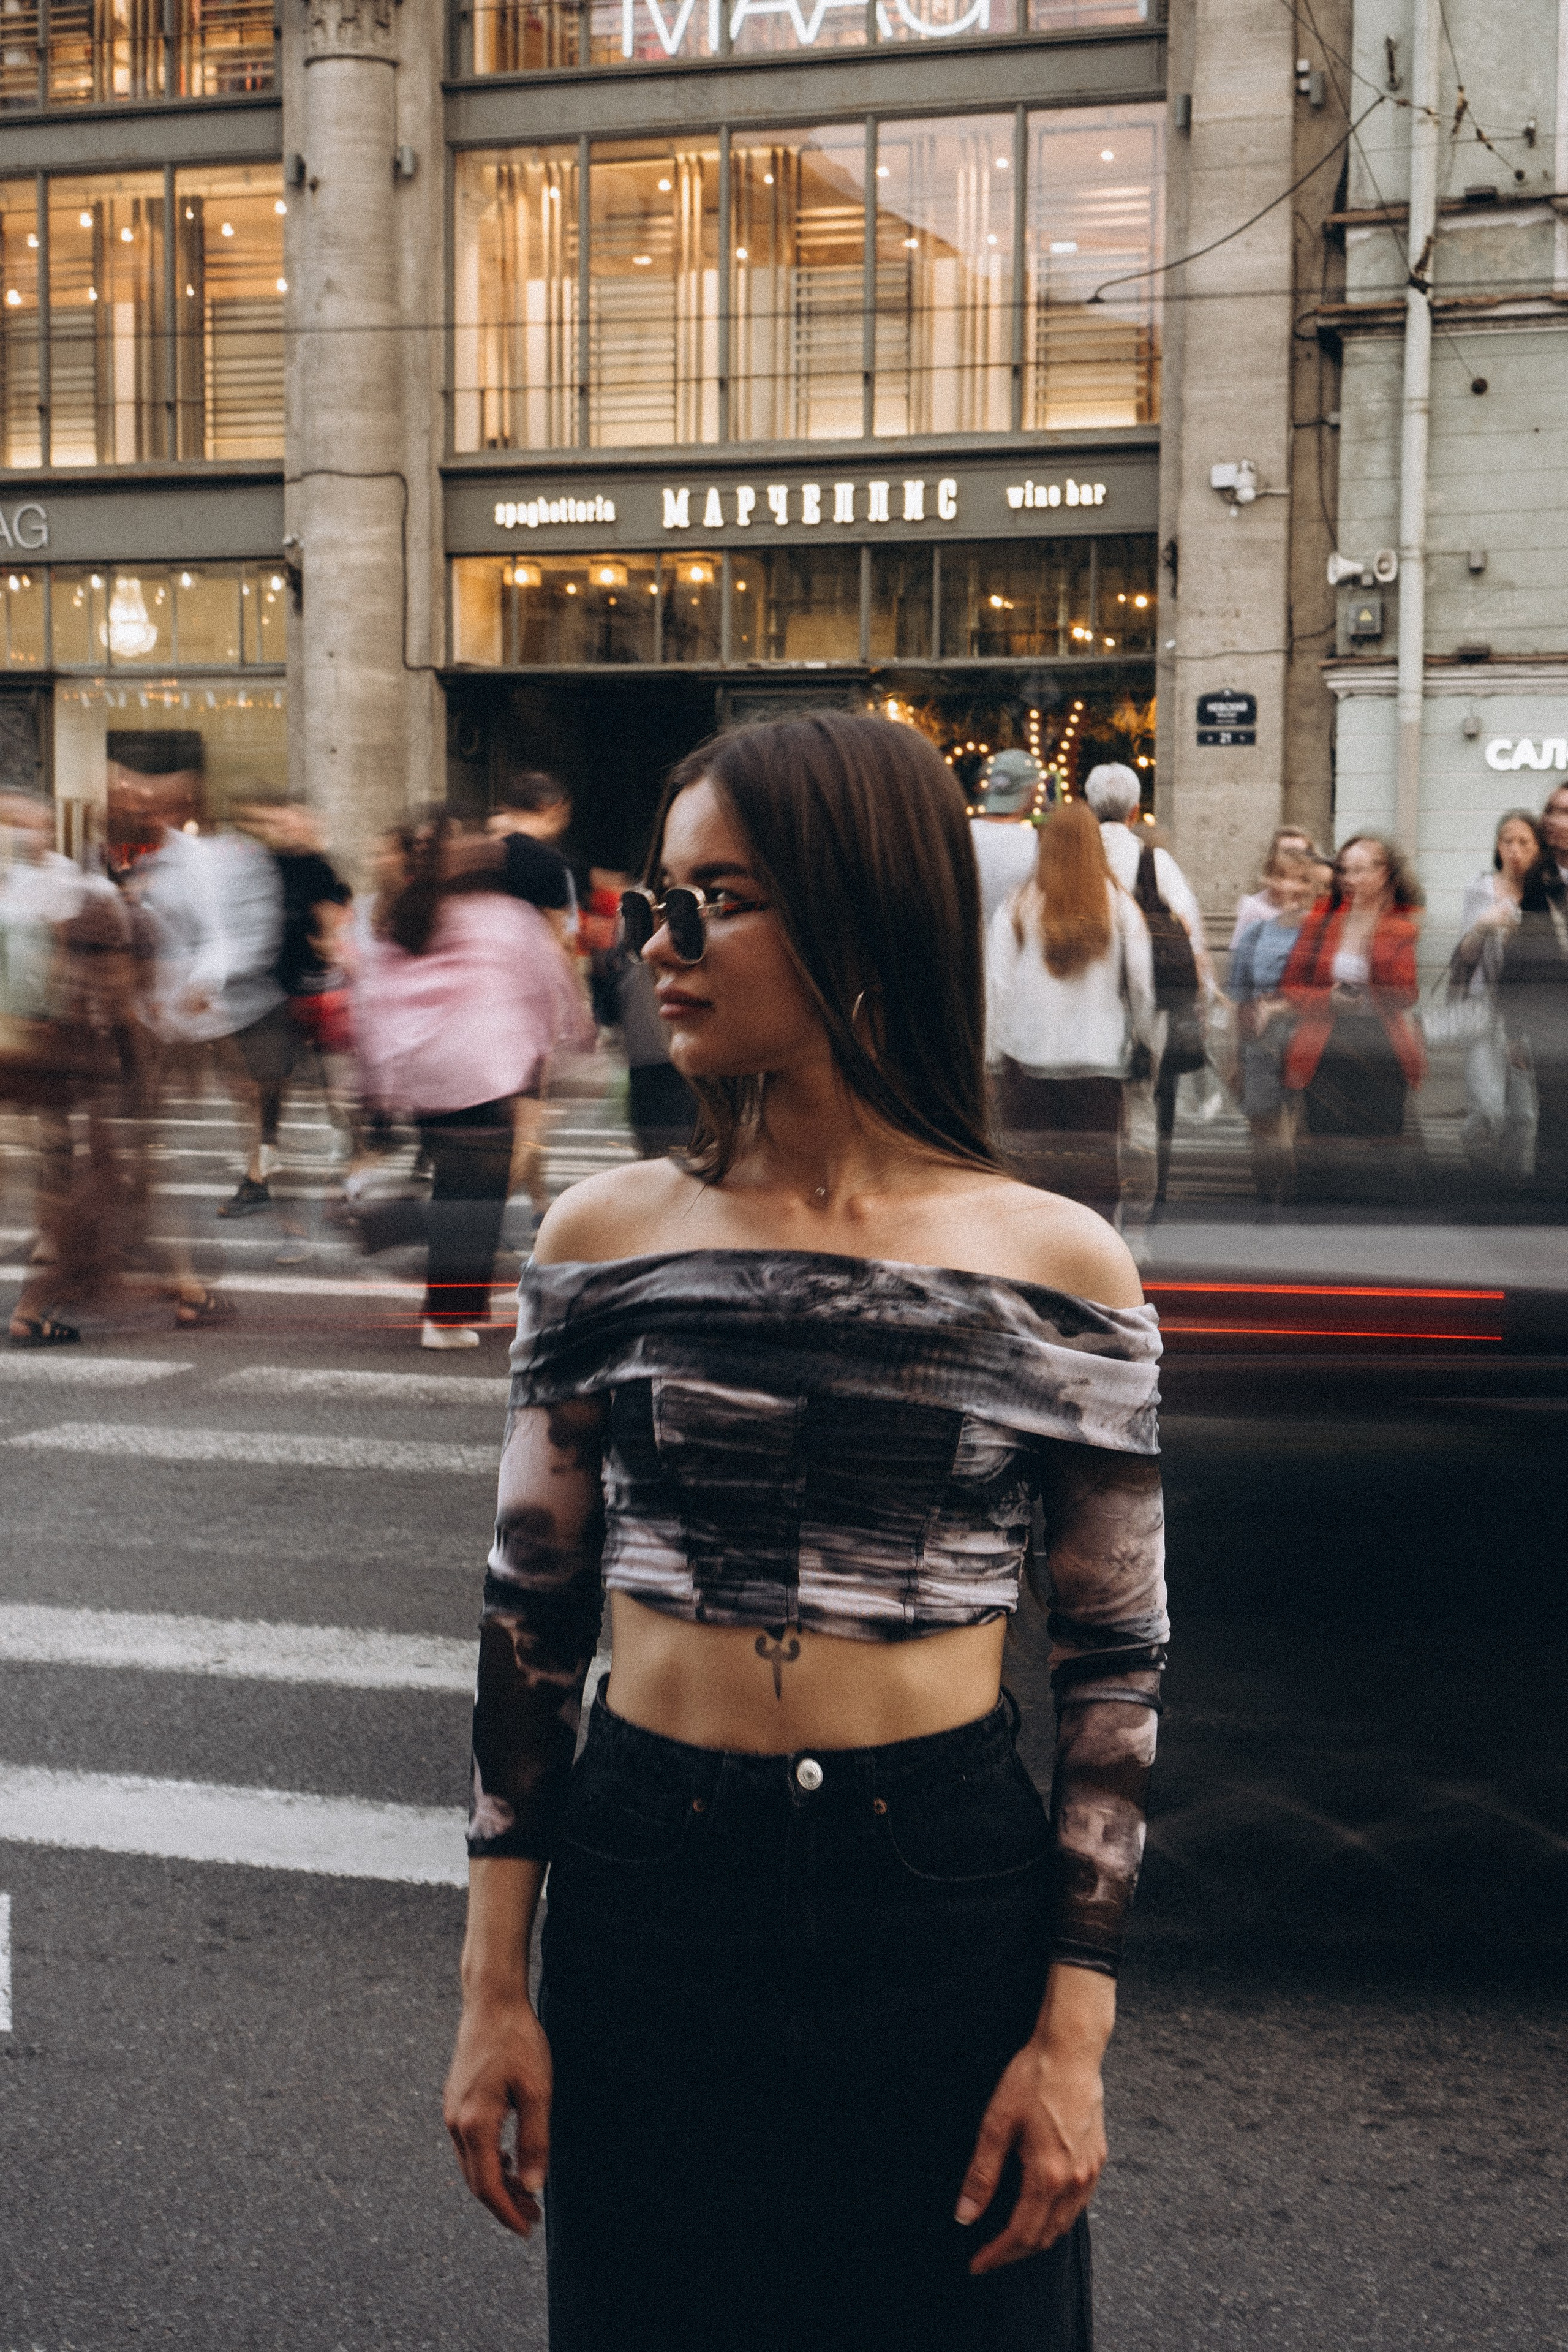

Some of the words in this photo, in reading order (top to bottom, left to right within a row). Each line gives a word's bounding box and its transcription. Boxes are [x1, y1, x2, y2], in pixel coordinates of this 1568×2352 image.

[1006, 480, 1061, 508] vino
[1066, 478, 1106, 507] bar
[1485, 738, 1568, 771] САЛ
